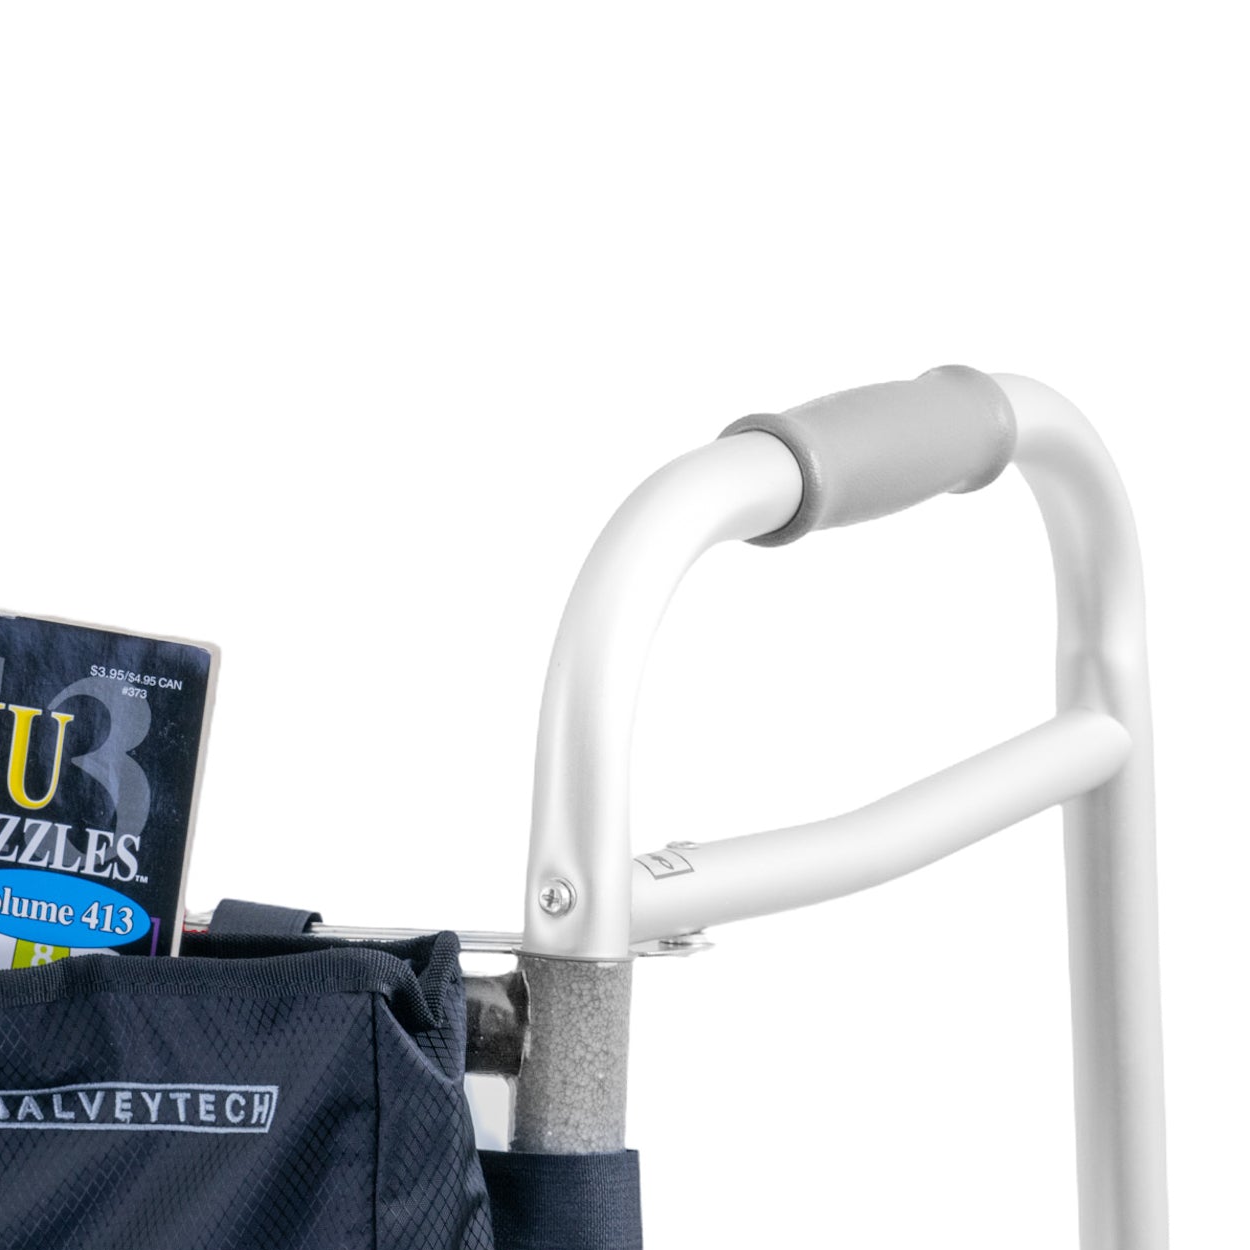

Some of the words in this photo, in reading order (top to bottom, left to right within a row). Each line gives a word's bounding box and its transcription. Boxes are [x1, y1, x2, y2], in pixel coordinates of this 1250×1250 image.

[90, 664, 157, 687] $3.95/$4.95
[158, 677, 183, 691] CAN
[121, 686, 148, 699] #373
[81, 901, 135, 935] 413
[17, 1090, 271, 1125] ALVEYTECH
